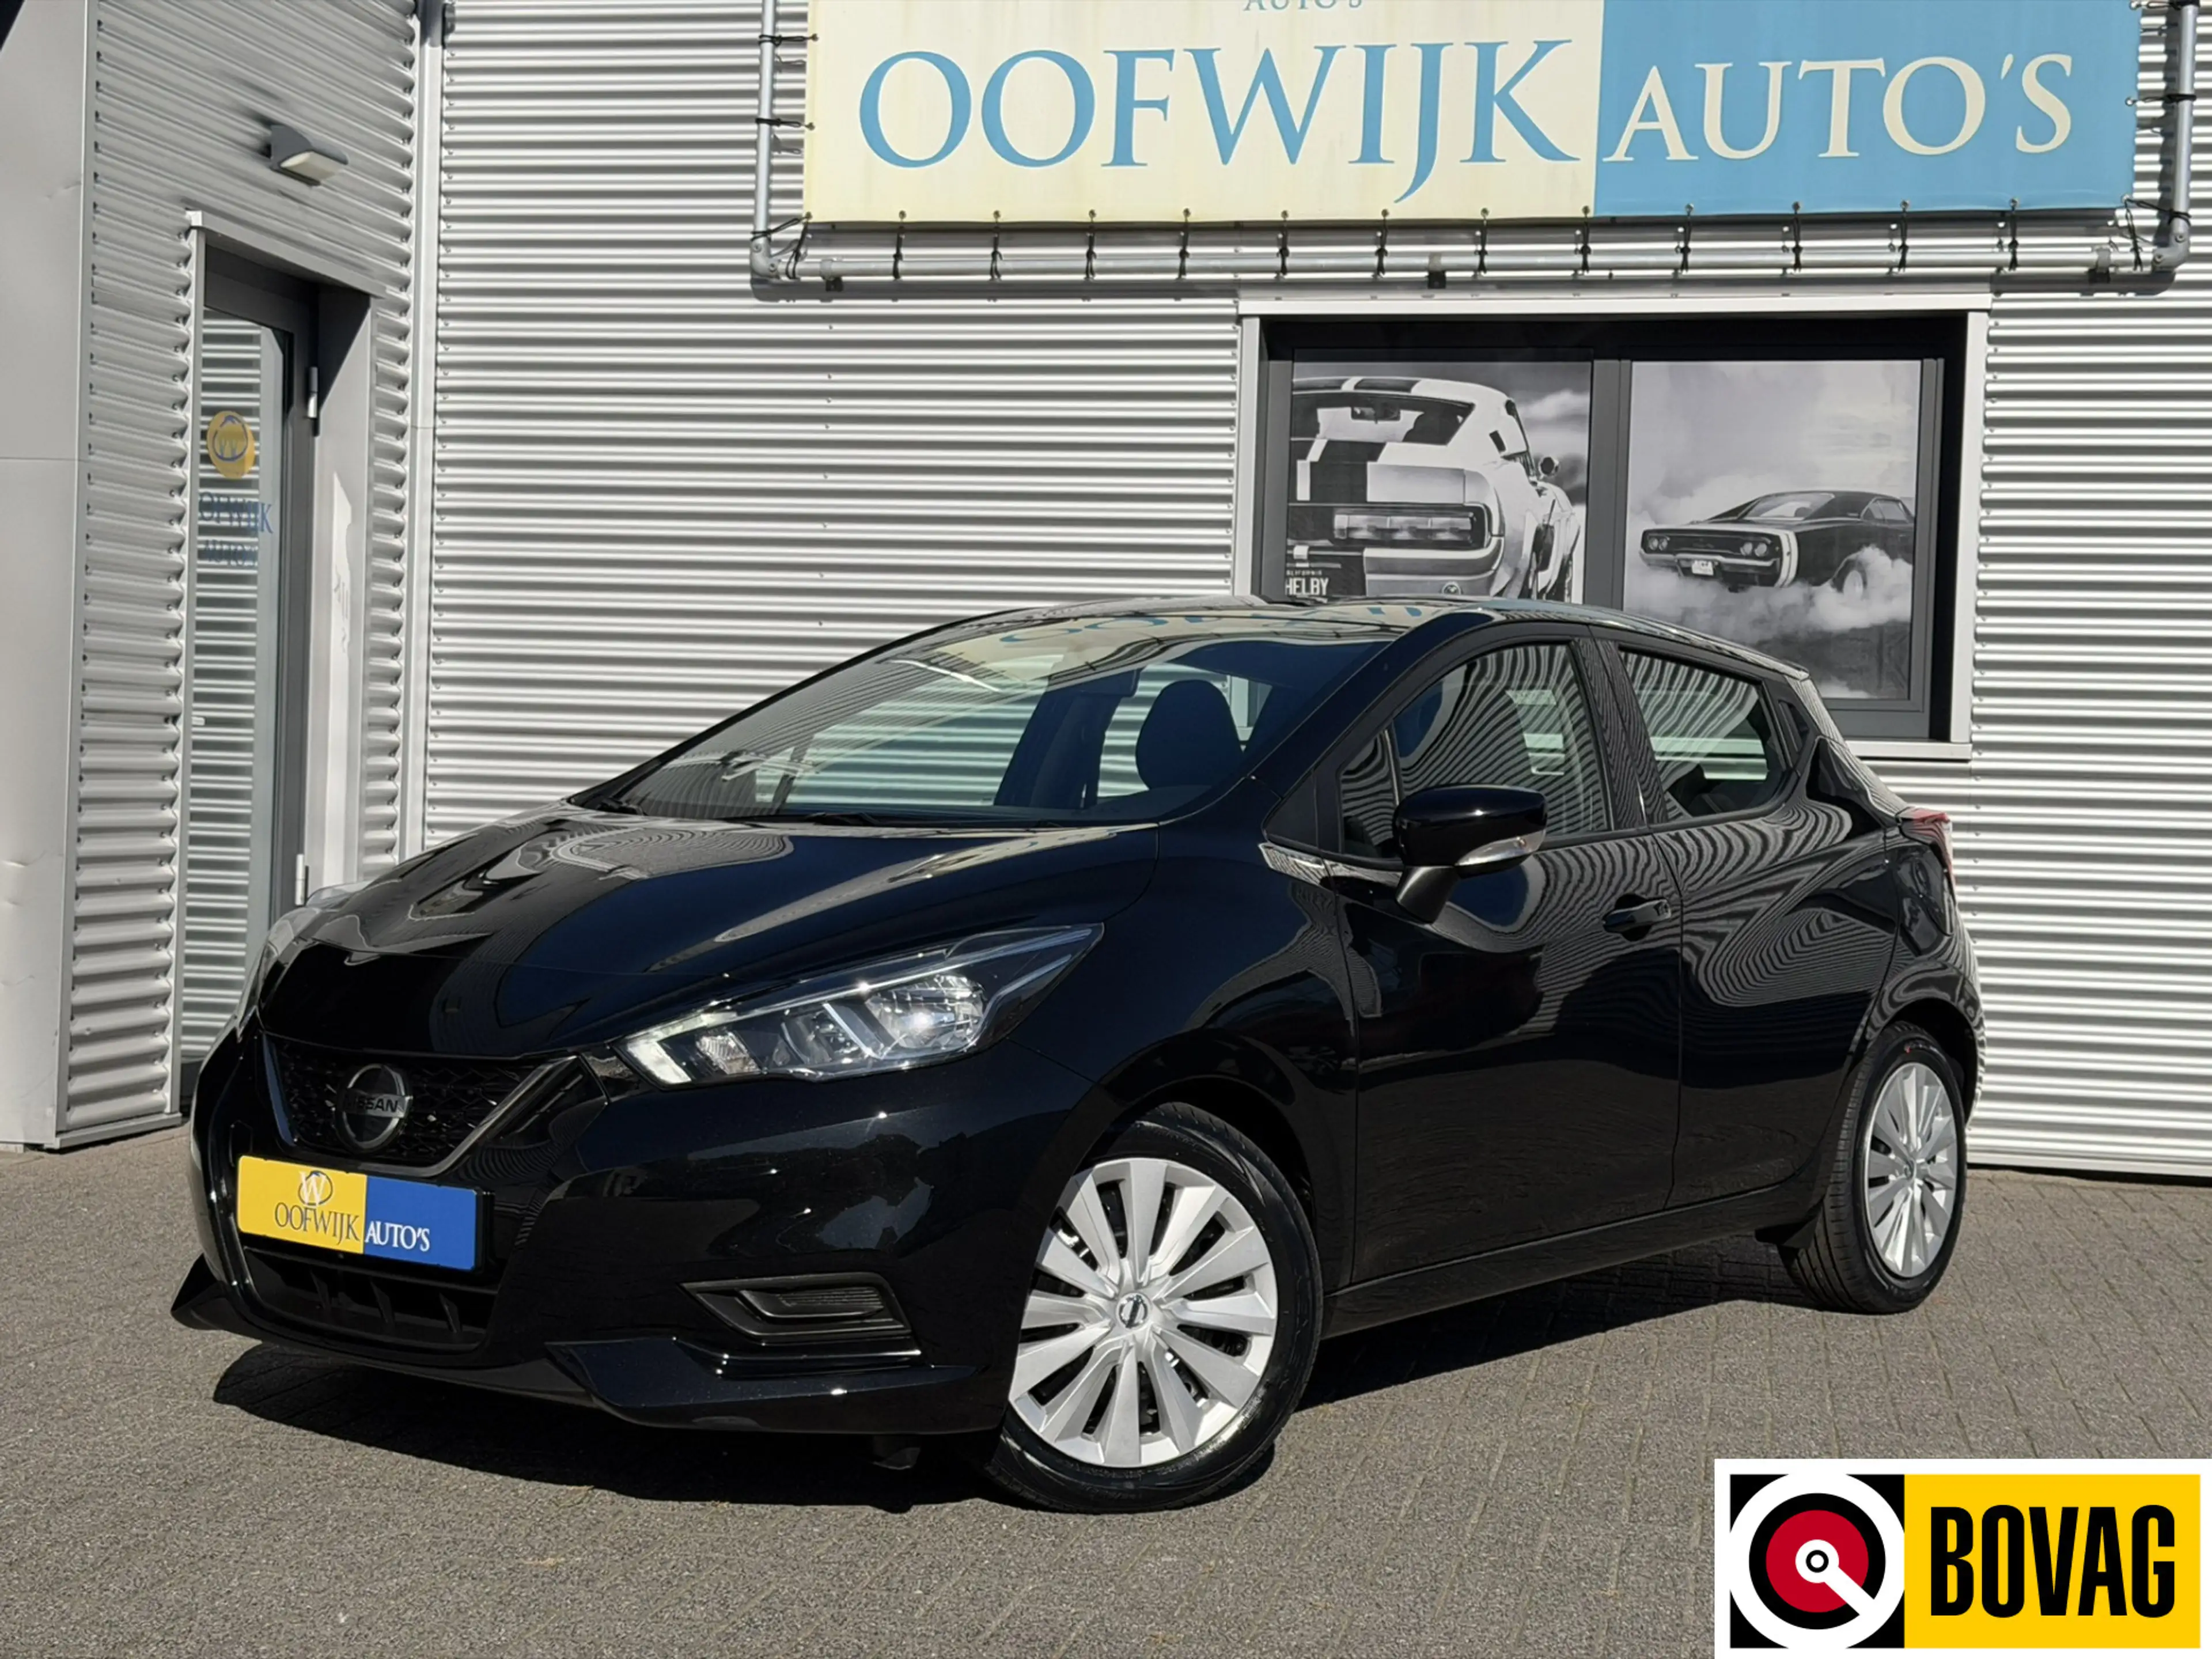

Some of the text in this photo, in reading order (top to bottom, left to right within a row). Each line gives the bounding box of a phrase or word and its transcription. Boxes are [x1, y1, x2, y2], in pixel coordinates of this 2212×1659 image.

[859, 39, 2073, 203] OOFWIJK AUTO'S
[343, 1094, 399, 1113] NISSAN
[275, 1202, 431, 1252] OOFWIJK AUTO'S
